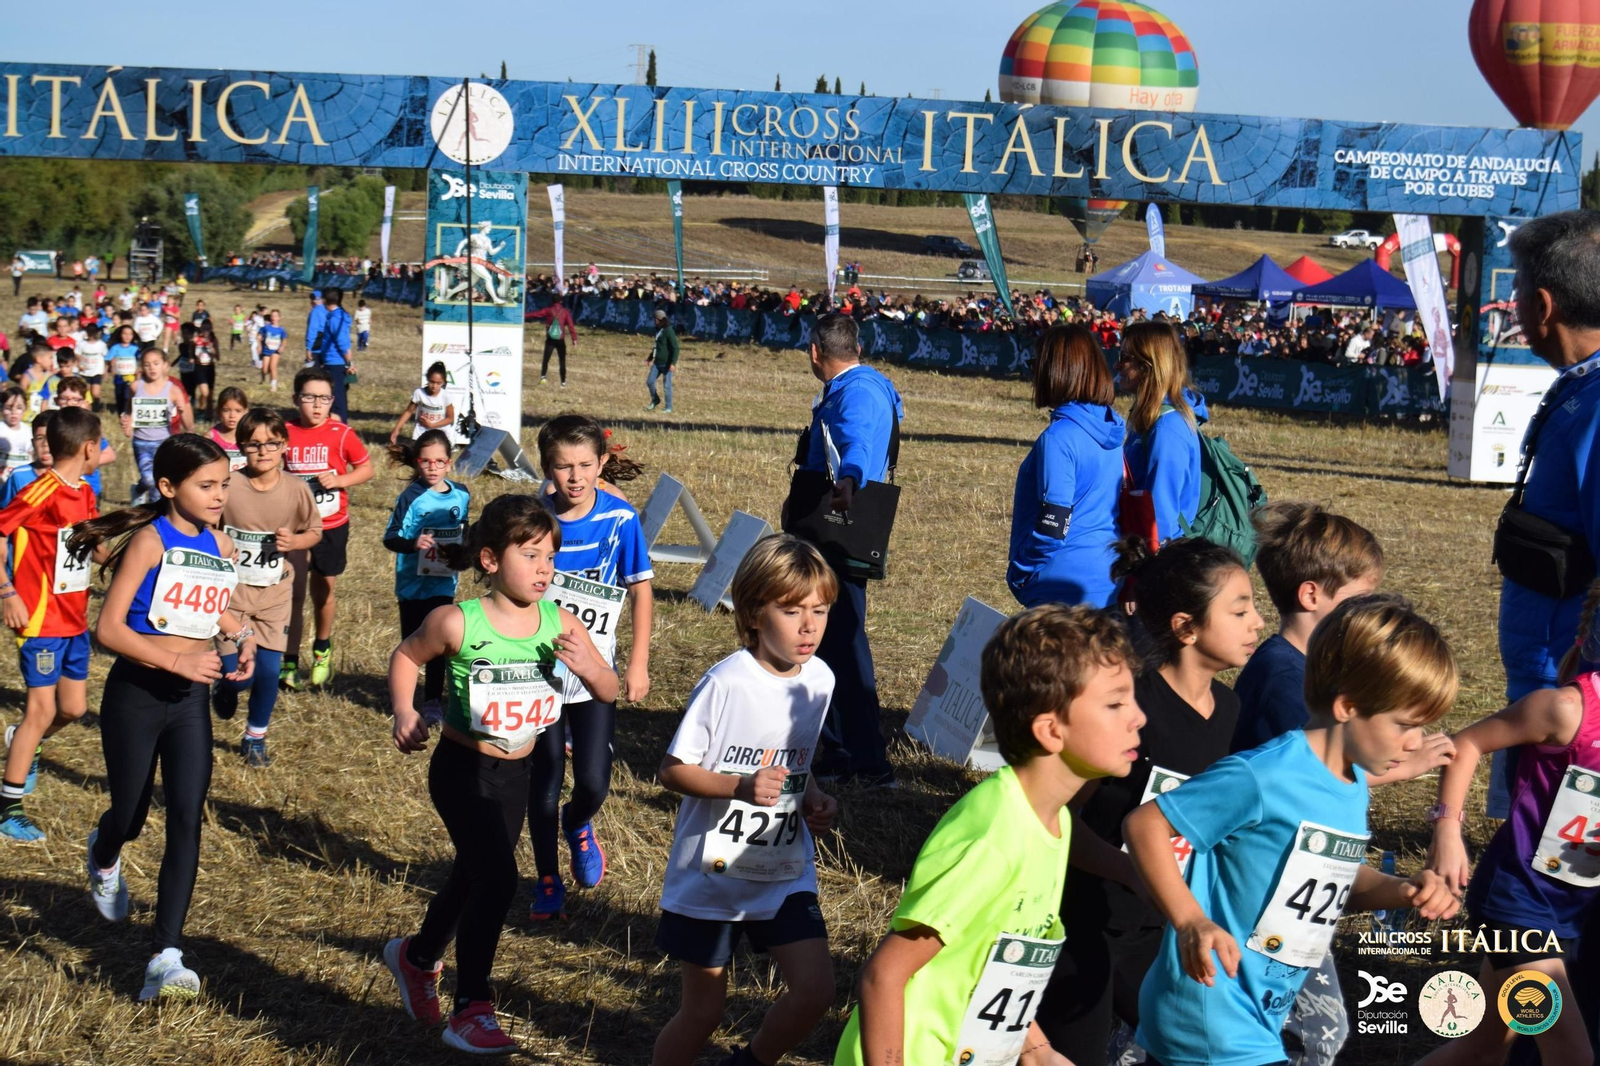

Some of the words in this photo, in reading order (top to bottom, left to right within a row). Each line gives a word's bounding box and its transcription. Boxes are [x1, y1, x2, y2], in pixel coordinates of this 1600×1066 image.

[2, 66, 329, 146] ITÁLICA
[1130, 88, 1158, 109] Hay
[559, 95, 727, 156] XLIII
[732, 104, 860, 141] CROSS
[731, 139, 906, 164] INTERNACIONAL
[918, 103, 1227, 186] ITÁLICA
[558, 154, 716, 177] INTERNATIONAL
[720, 161, 779, 180] CROSS
[782, 164, 875, 183] COUNTRY
[1334, 150, 1444, 168] CAMPEONATO
[1447, 155, 1467, 169] DE
[1470, 157, 1562, 173] ANDALUCÍA
[1370, 166, 1390, 179] DE
[1393, 168, 1450, 182] CAMPO
[1453, 170, 1465, 183] A
[479, 190, 515, 200] Sevilla
[1404, 181, 1436, 196] POR
[1438, 183, 1495, 198] CLUBES
[1257, 382, 1284, 399] Sevilla
[189, 554, 219, 569] ITÁLICA
[163, 582, 231, 614] 4480
[568, 578, 606, 597] ITÁLICA
[481, 694, 556, 731] 4542
[940, 676, 985, 734] ITÁLICA
[723, 745, 796, 766] CIRCUITO
[719, 809, 799, 847] 4279
[977, 988, 1036, 1032] 41
